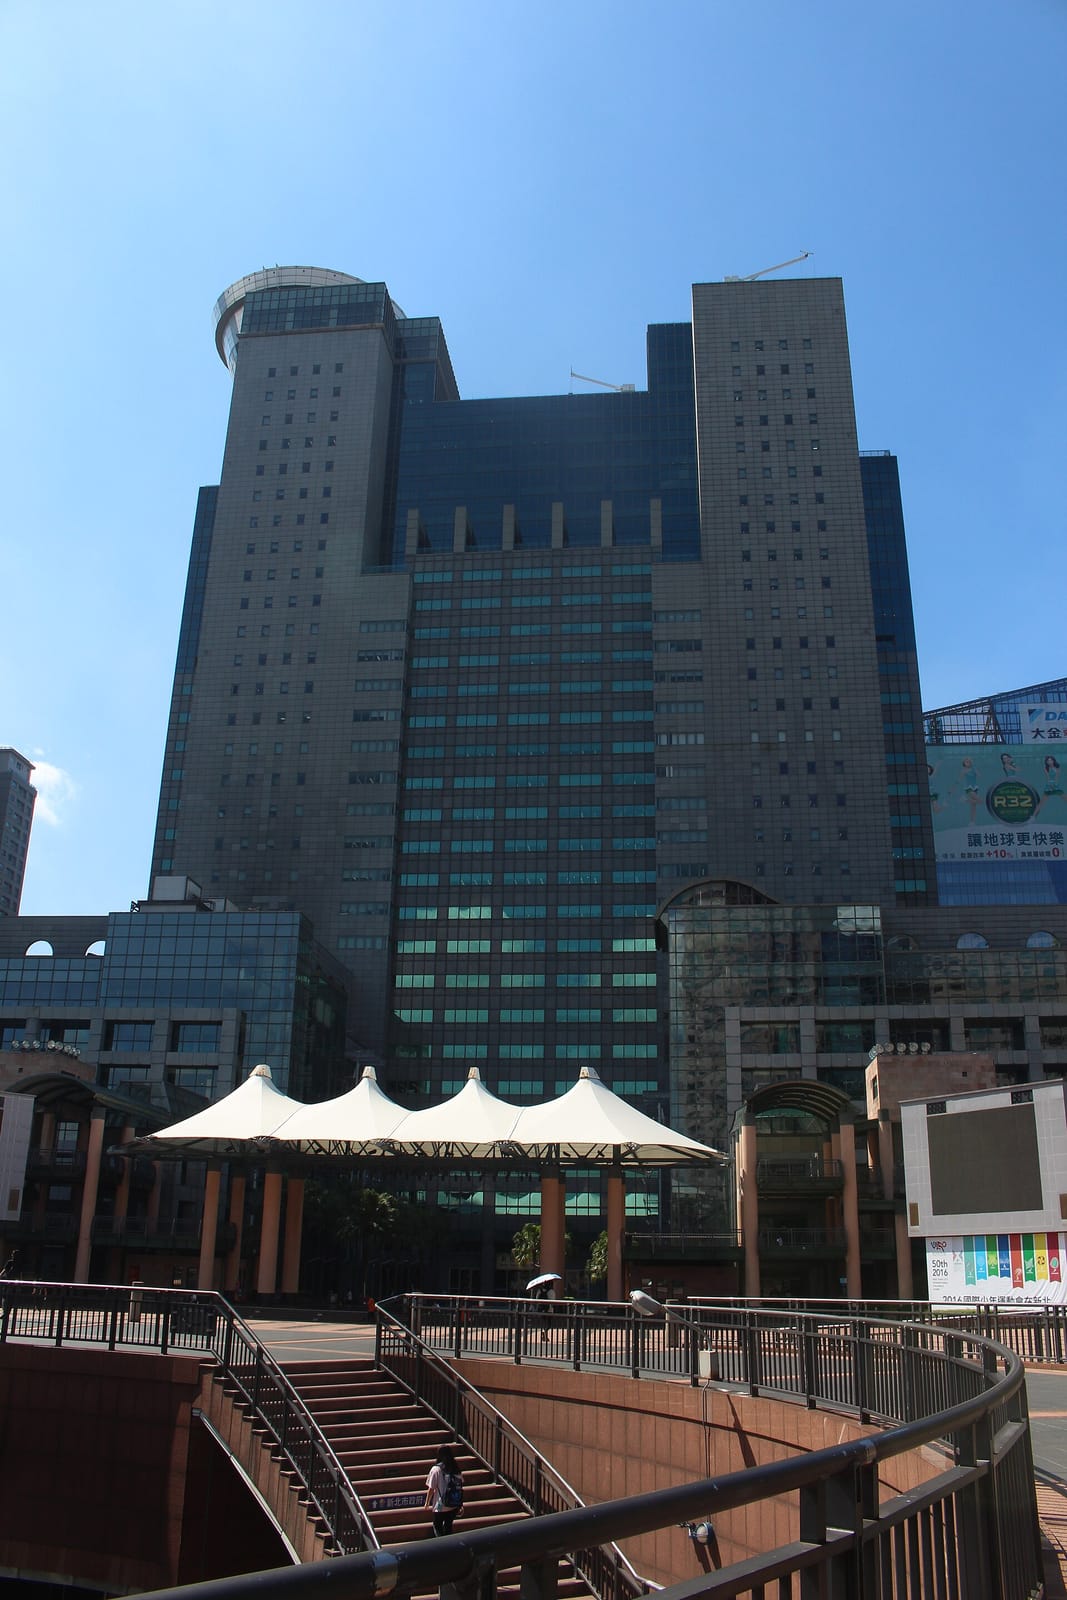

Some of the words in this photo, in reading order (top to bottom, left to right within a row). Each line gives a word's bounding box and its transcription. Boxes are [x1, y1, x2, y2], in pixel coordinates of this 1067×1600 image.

[994, 795, 1033, 808] R32
[967, 831, 1064, 847] 讓地球更快樂
[932, 1259, 948, 1268] 50th
[932, 1268, 949, 1277] 2016
[386, 1495, 423, 1508] 新北市政府
